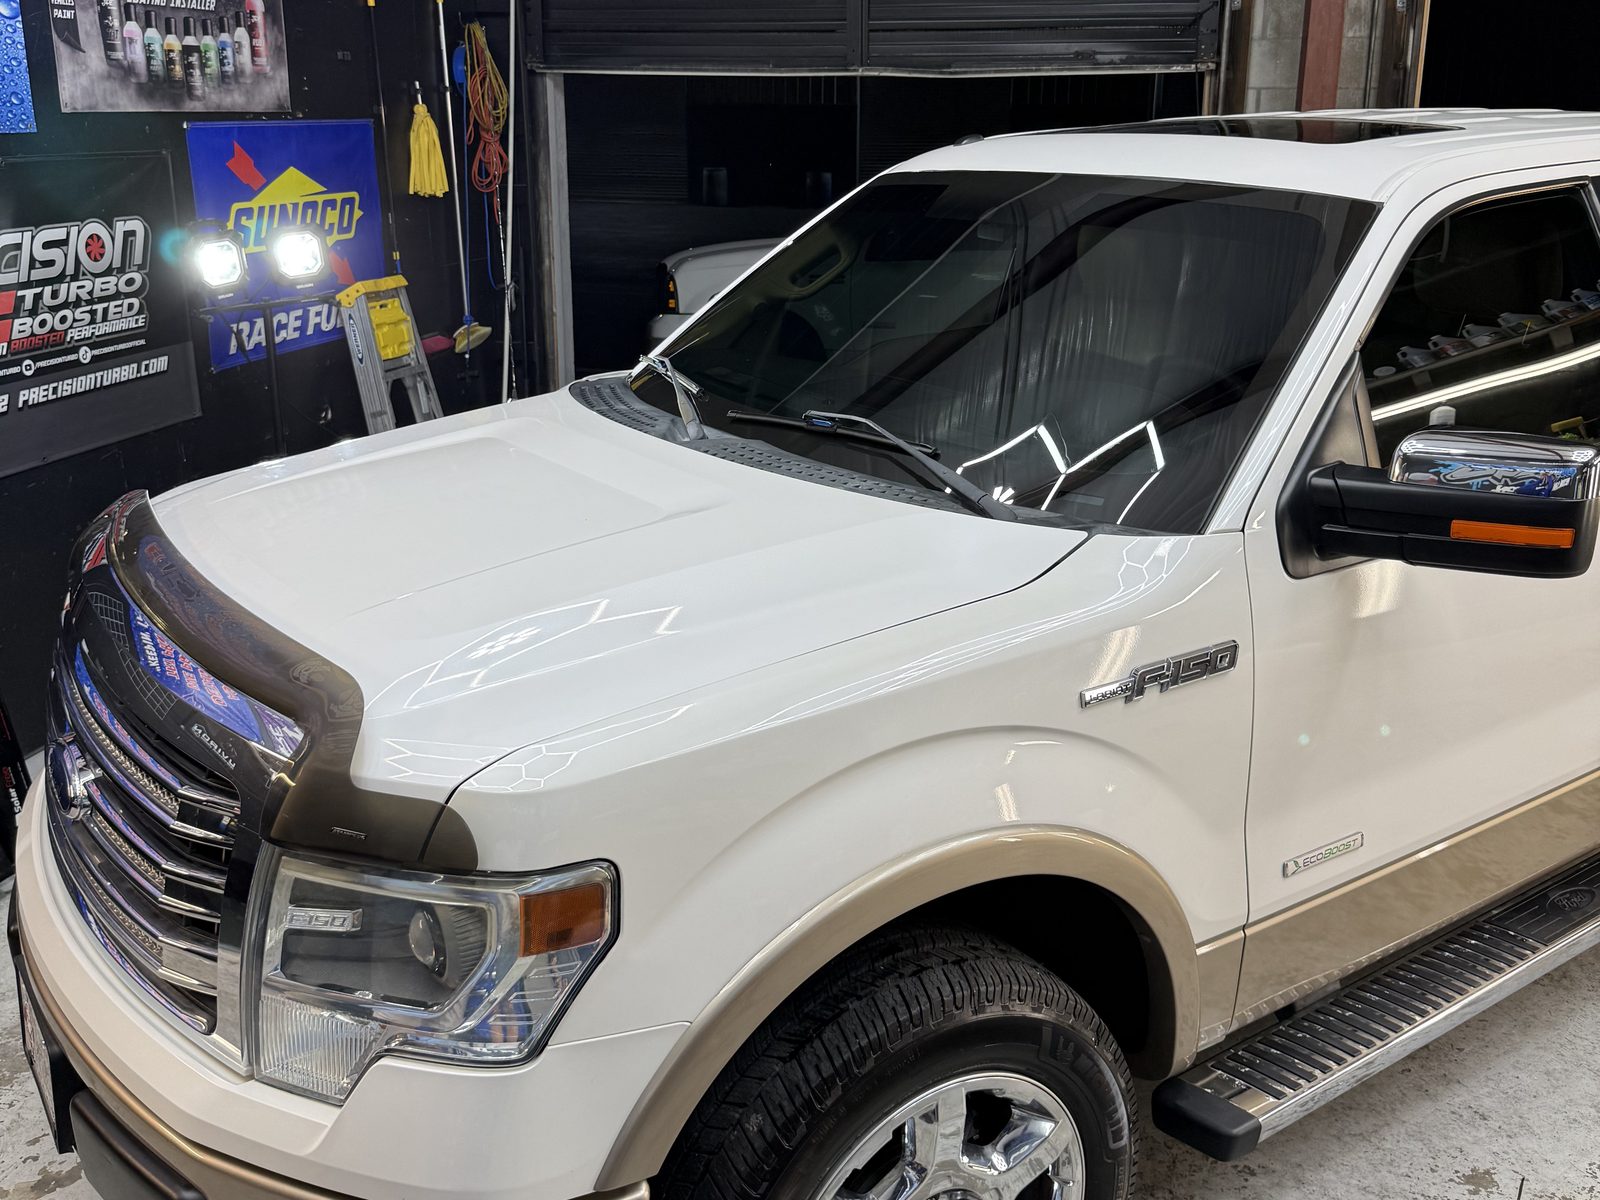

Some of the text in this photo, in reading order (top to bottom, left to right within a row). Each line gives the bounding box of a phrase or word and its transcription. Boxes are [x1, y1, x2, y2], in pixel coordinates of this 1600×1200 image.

[53, 8, 75, 19] PAINT
[170, 0, 216, 11] INSTALLER
[233, 197, 356, 249] SUNOCO
[17, 271, 142, 311] TURBO
[10, 332, 65, 353] BOOSTED
[66, 314, 147, 342] PERFORMANCE
[11, 297, 141, 340] BOOSTED
[228, 308, 303, 356] RACE
[351, 321, 363, 358] WERNER
[18, 355, 169, 409] PRECISIONTURBO.COM
[1087, 681, 1133, 705] LARIAT
[1302, 837, 1359, 868] ECOBOOST
